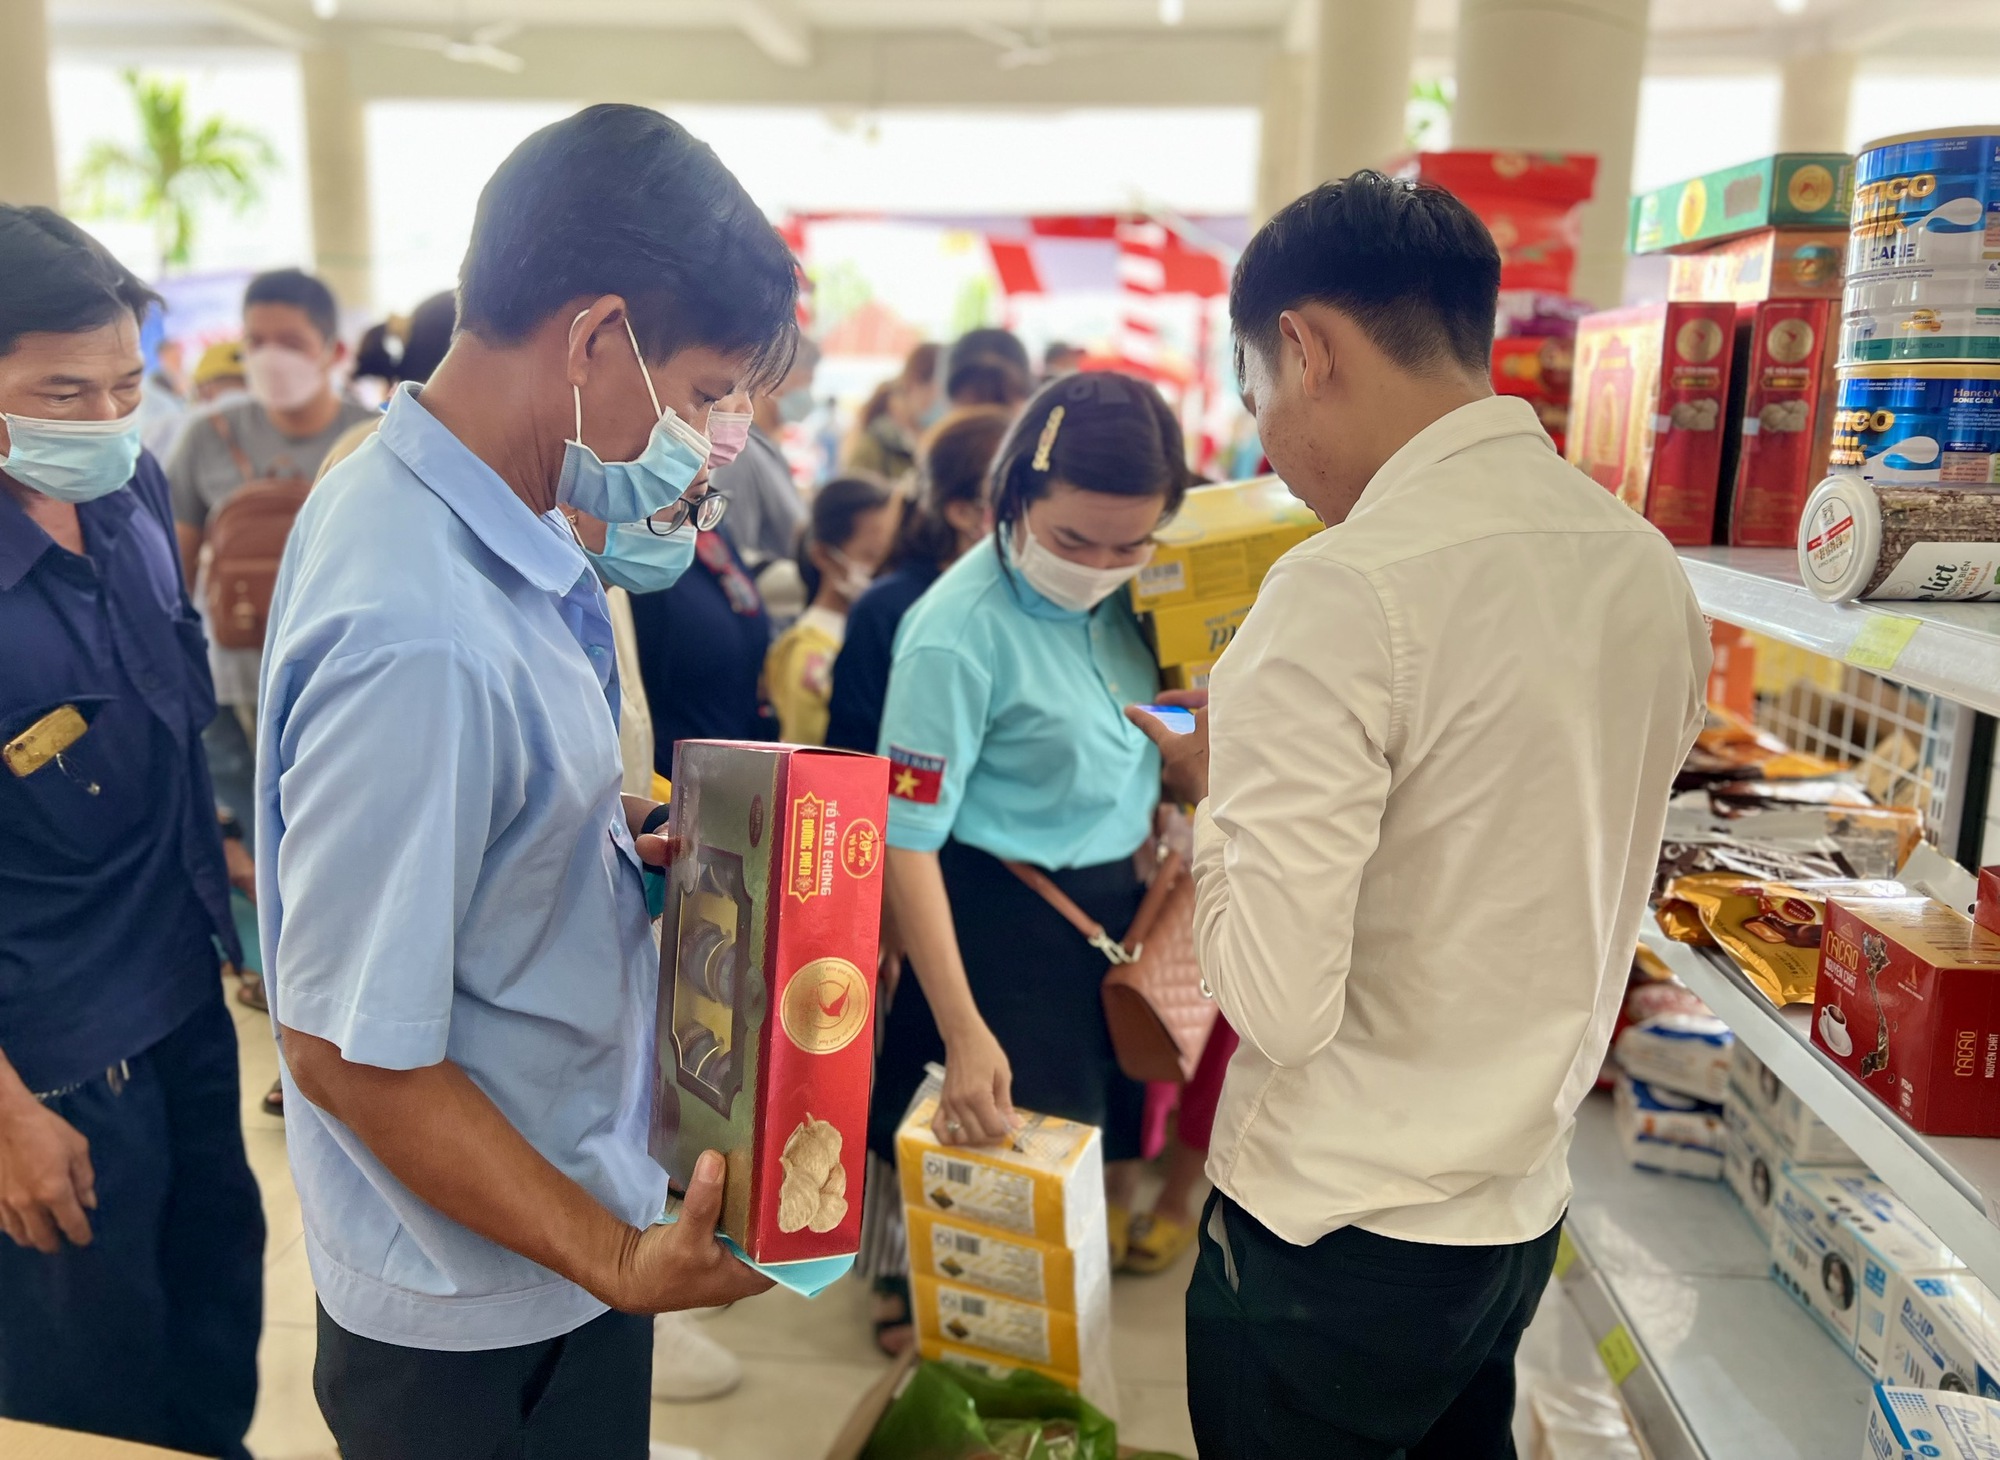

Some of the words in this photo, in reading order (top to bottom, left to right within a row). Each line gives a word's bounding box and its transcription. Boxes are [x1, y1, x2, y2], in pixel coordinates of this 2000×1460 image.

[1826, 930, 1858, 970] CACAO
[1954, 1031, 1976, 1077] CACAO
[1985, 1051, 1997, 1078] NGUYÊN
